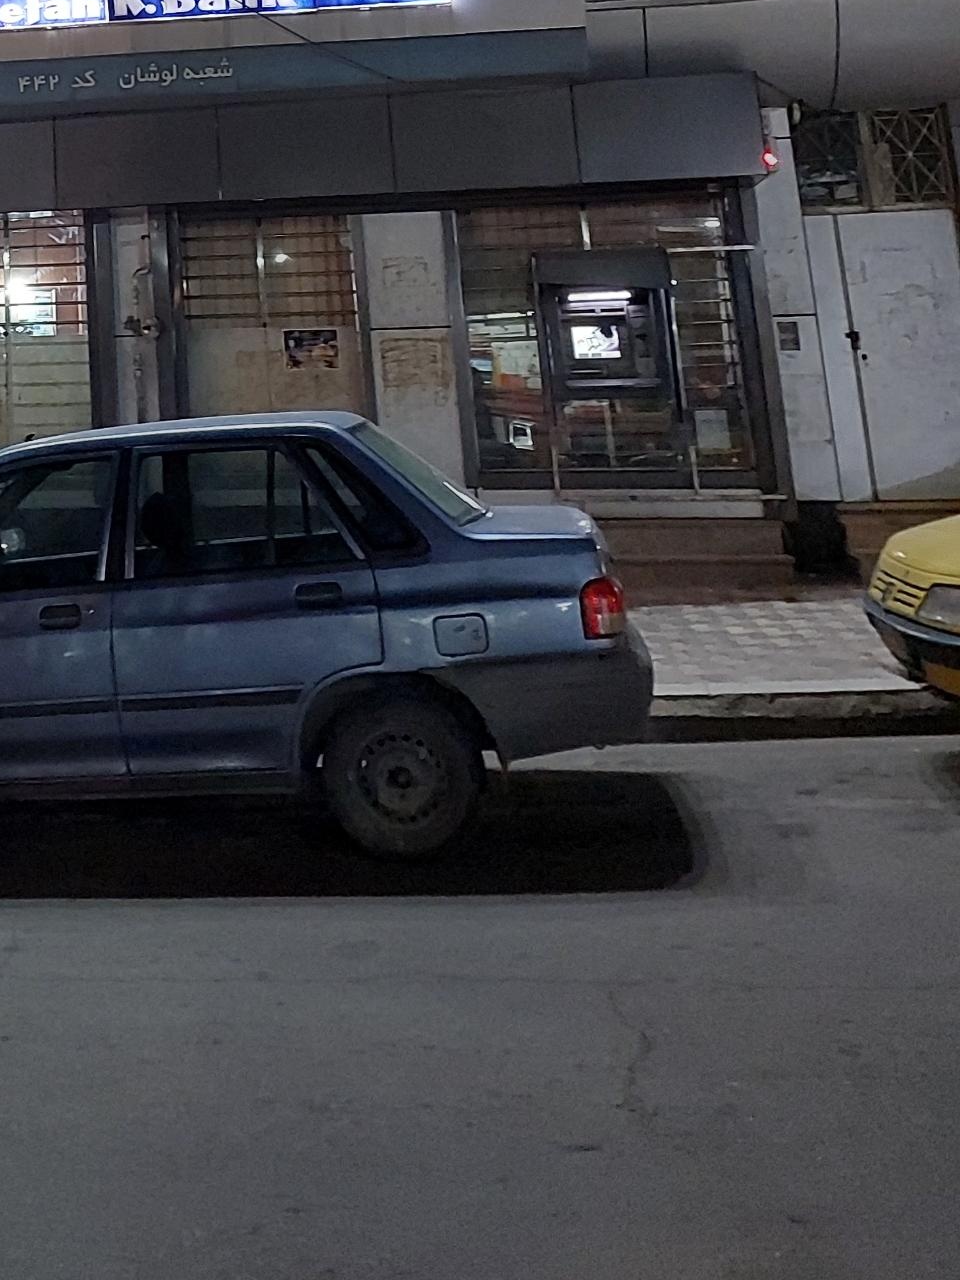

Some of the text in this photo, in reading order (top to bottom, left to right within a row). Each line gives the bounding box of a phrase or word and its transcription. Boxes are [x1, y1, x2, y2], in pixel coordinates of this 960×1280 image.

[17, 56, 234, 93] شعبه لوشان کد ۴۴۲
